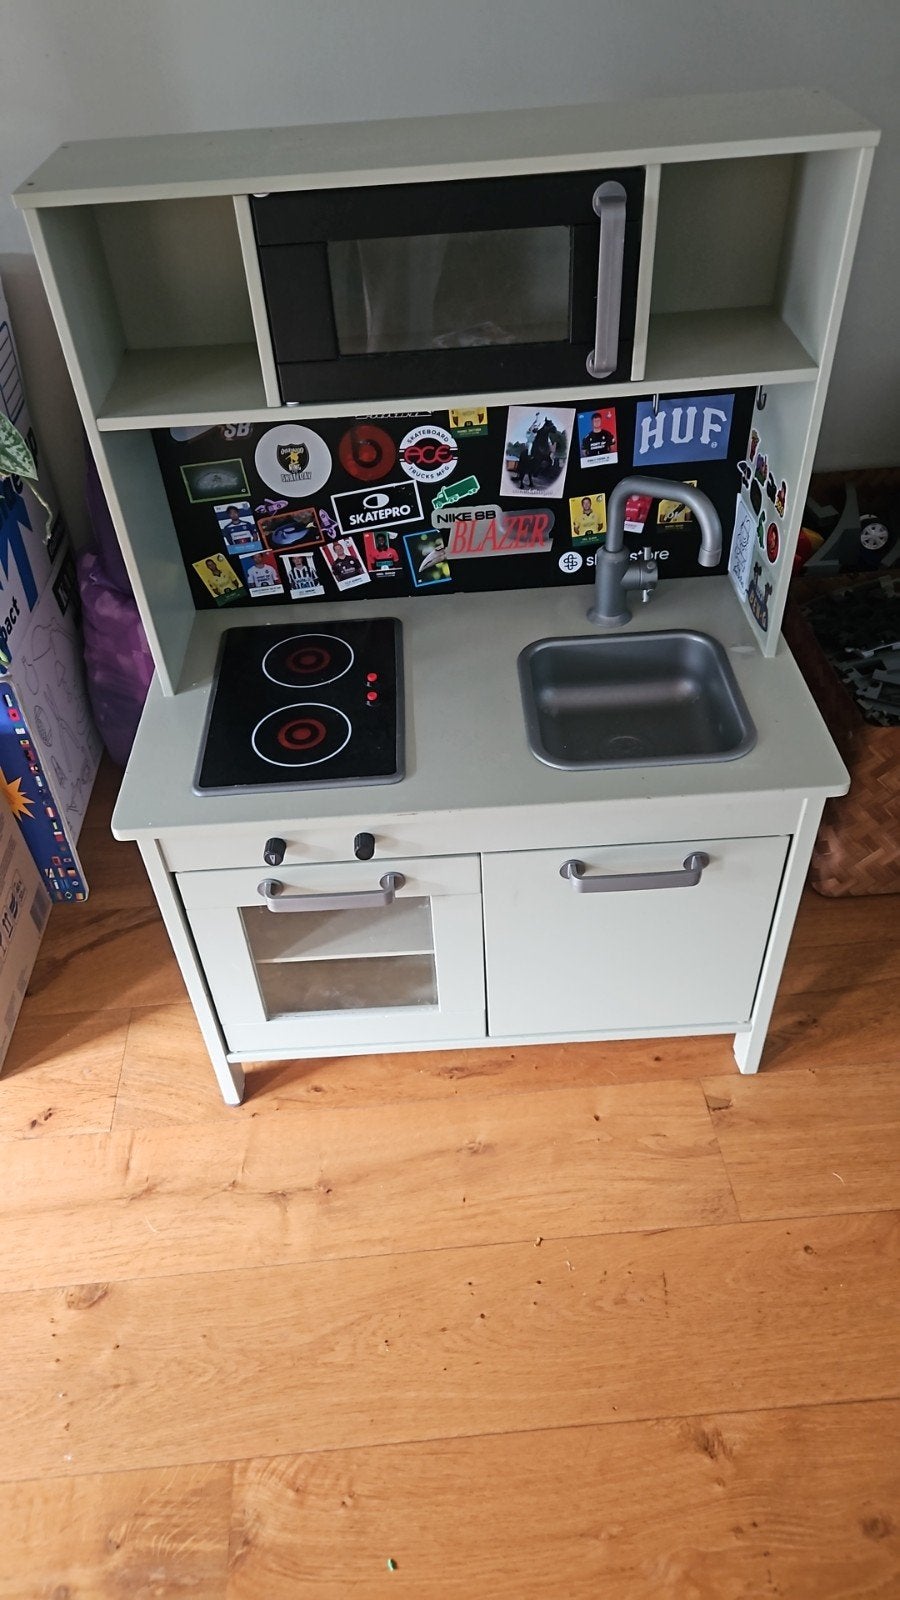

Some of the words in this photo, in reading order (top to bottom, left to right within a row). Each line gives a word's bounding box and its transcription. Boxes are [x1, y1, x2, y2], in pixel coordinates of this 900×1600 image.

[223, 422, 252, 439] SB
[407, 428, 450, 444] SKATEBOARD
[638, 406, 728, 455] HUF
[404, 444, 454, 465] ACE
[408, 466, 435, 479] TRUCKS
[436, 465, 450, 477] MFG
[349, 504, 411, 526] SKATEPRO
[436, 511, 473, 524] NIKE
[450, 513, 550, 555] BLAZER
